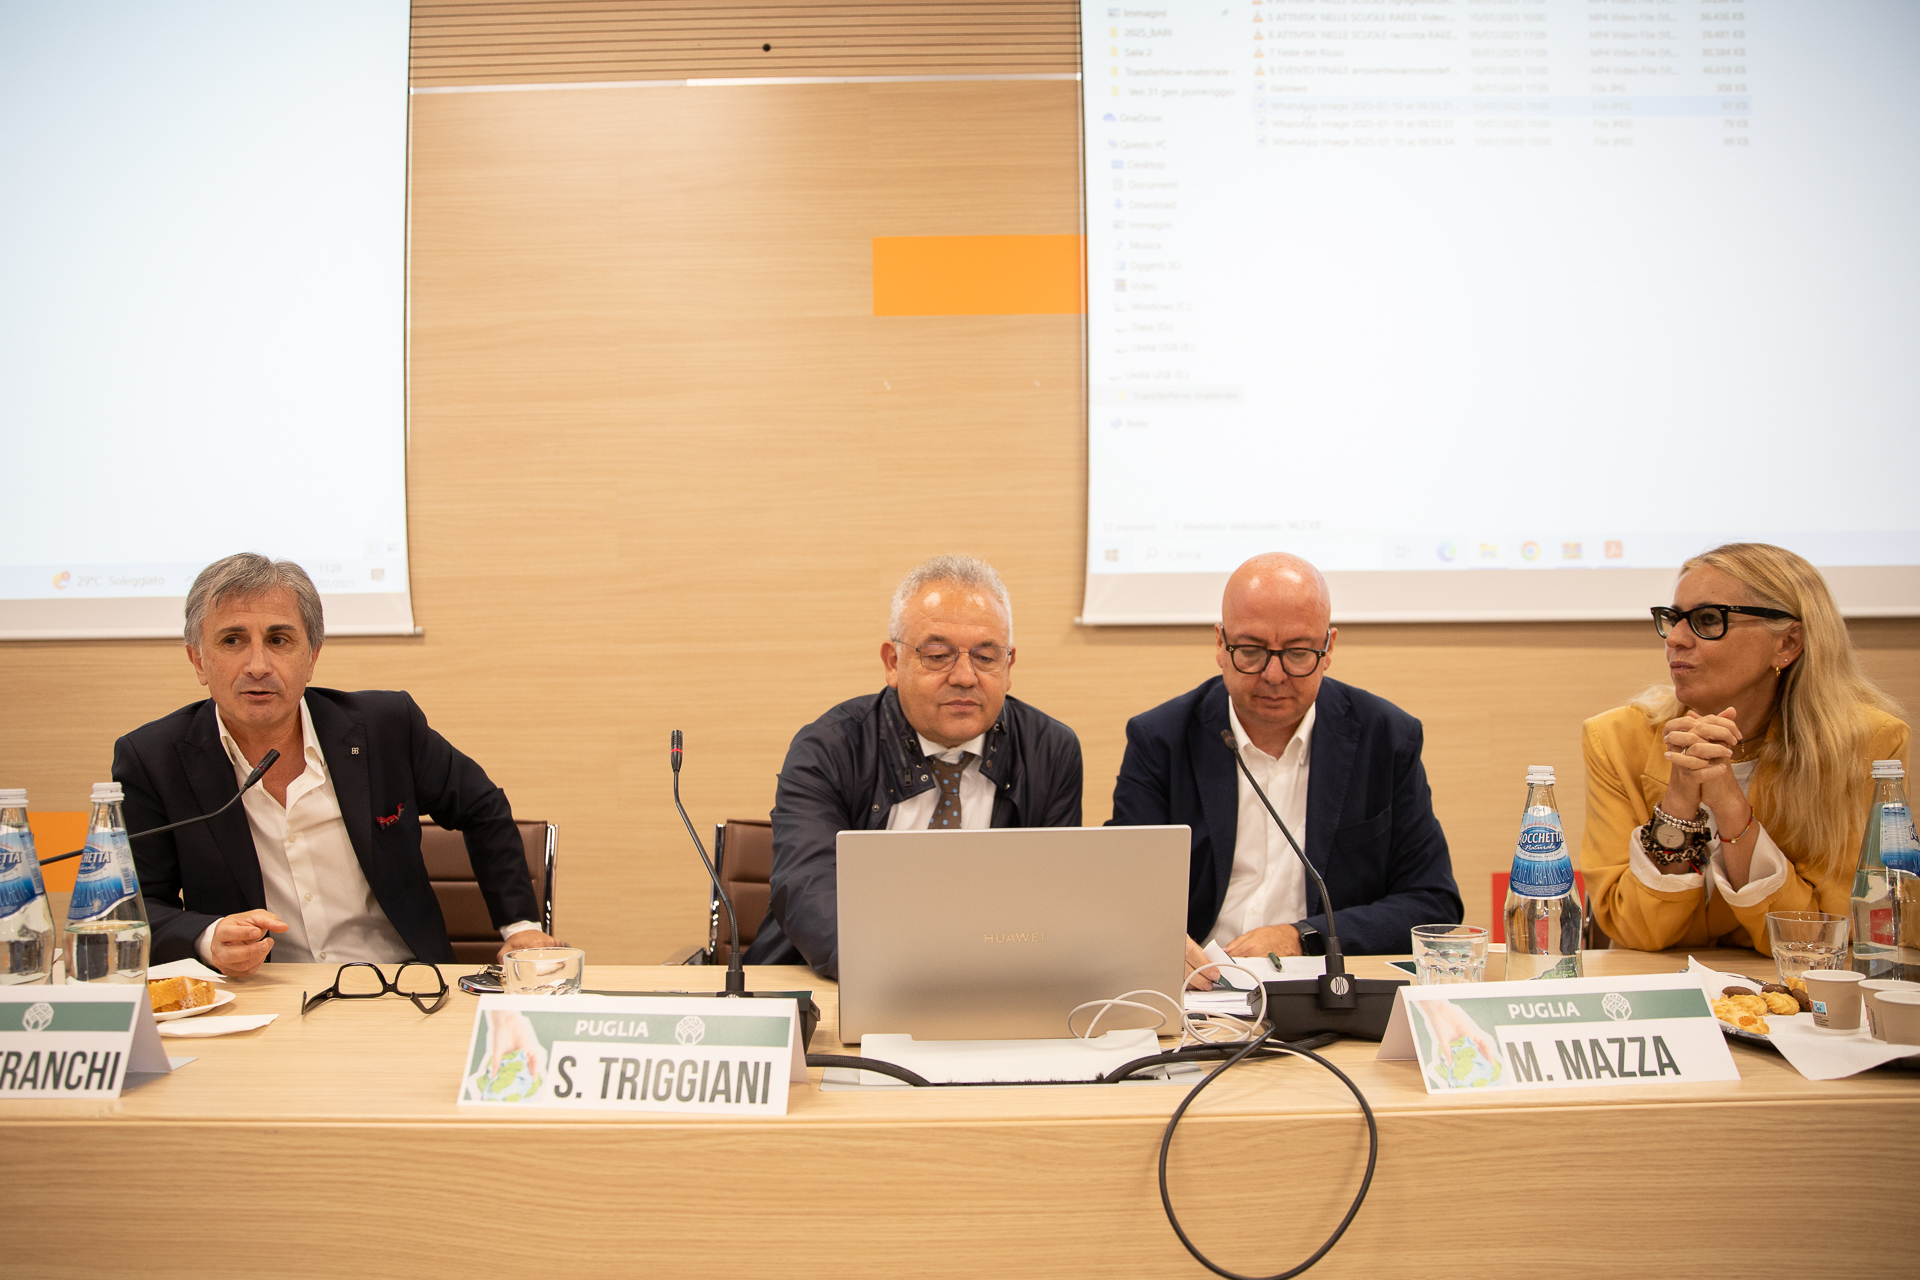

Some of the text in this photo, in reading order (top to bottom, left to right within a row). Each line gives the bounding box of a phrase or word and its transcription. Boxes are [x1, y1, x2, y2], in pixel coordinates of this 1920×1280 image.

[1124, 9, 1166, 19] Immagini
[1321, 13, 1347, 22] NELLE
[1612, 13, 1636, 22] Video
[1641, 13, 1655, 22] File
[1733, 12, 1745, 22] KB
[1322, 31, 1348, 40] NELLE
[1612, 31, 1637, 40] Video
[1641, 31, 1655, 40] File
[1734, 30, 1745, 40] KB
[1125, 48, 1152, 58] Sala 2
[1613, 48, 1638, 58] Video
[1642, 48, 1656, 58] File
[1734, 48, 1746, 58] KB
[1278, 66, 1314, 75] EVENTO
[1317, 66, 1348, 75] FINALE
[1614, 66, 1639, 76] Video
[1642, 66, 1656, 76] File
[1735, 66, 1746, 76] KB
[1129, 88, 1145, 98] Ven
[1162, 88, 1178, 98] gen
[1735, 84, 1747, 93] KB
[1271, 102, 1317, 112] WhatsApp
[1321, 102, 1348, 112] Image
[1736, 101, 1748, 111] KB
[1120, 114, 1162, 123] OneDrive
[1272, 120, 1318, 130] WhatsApp
[1322, 120, 1349, 130] Image
[1121, 140, 1167, 150] Questo PC
[1273, 138, 1318, 148] WhatsApp
[1323, 138, 1350, 148] Image
[1128, 161, 1165, 170] Desktop
[1128, 181, 1178, 190] Documenti
[1129, 201, 1177, 210] Download
[1130, 222, 1172, 231] Immagini
[1130, 242, 1162, 250] Musica
[1131, 261, 1165, 271] Oggetti
[1131, 282, 1158, 290] Video
[1132, 303, 1173, 312] Windows
[1168, 549, 1202, 560] Cerca
[77, 575, 165, 589] 29°C Soleggiato
[1518, 831, 1565, 846] ROCCHETTA
[984, 932, 1045, 943] HUAWEI
[1508, 1002, 1581, 1020] PUGLIA
[575, 1019, 649, 1038] PUGLIA
[1506, 1035, 1682, 1083] M. MAZZA
[554, 1055, 772, 1105] S. TRIGGIANI
